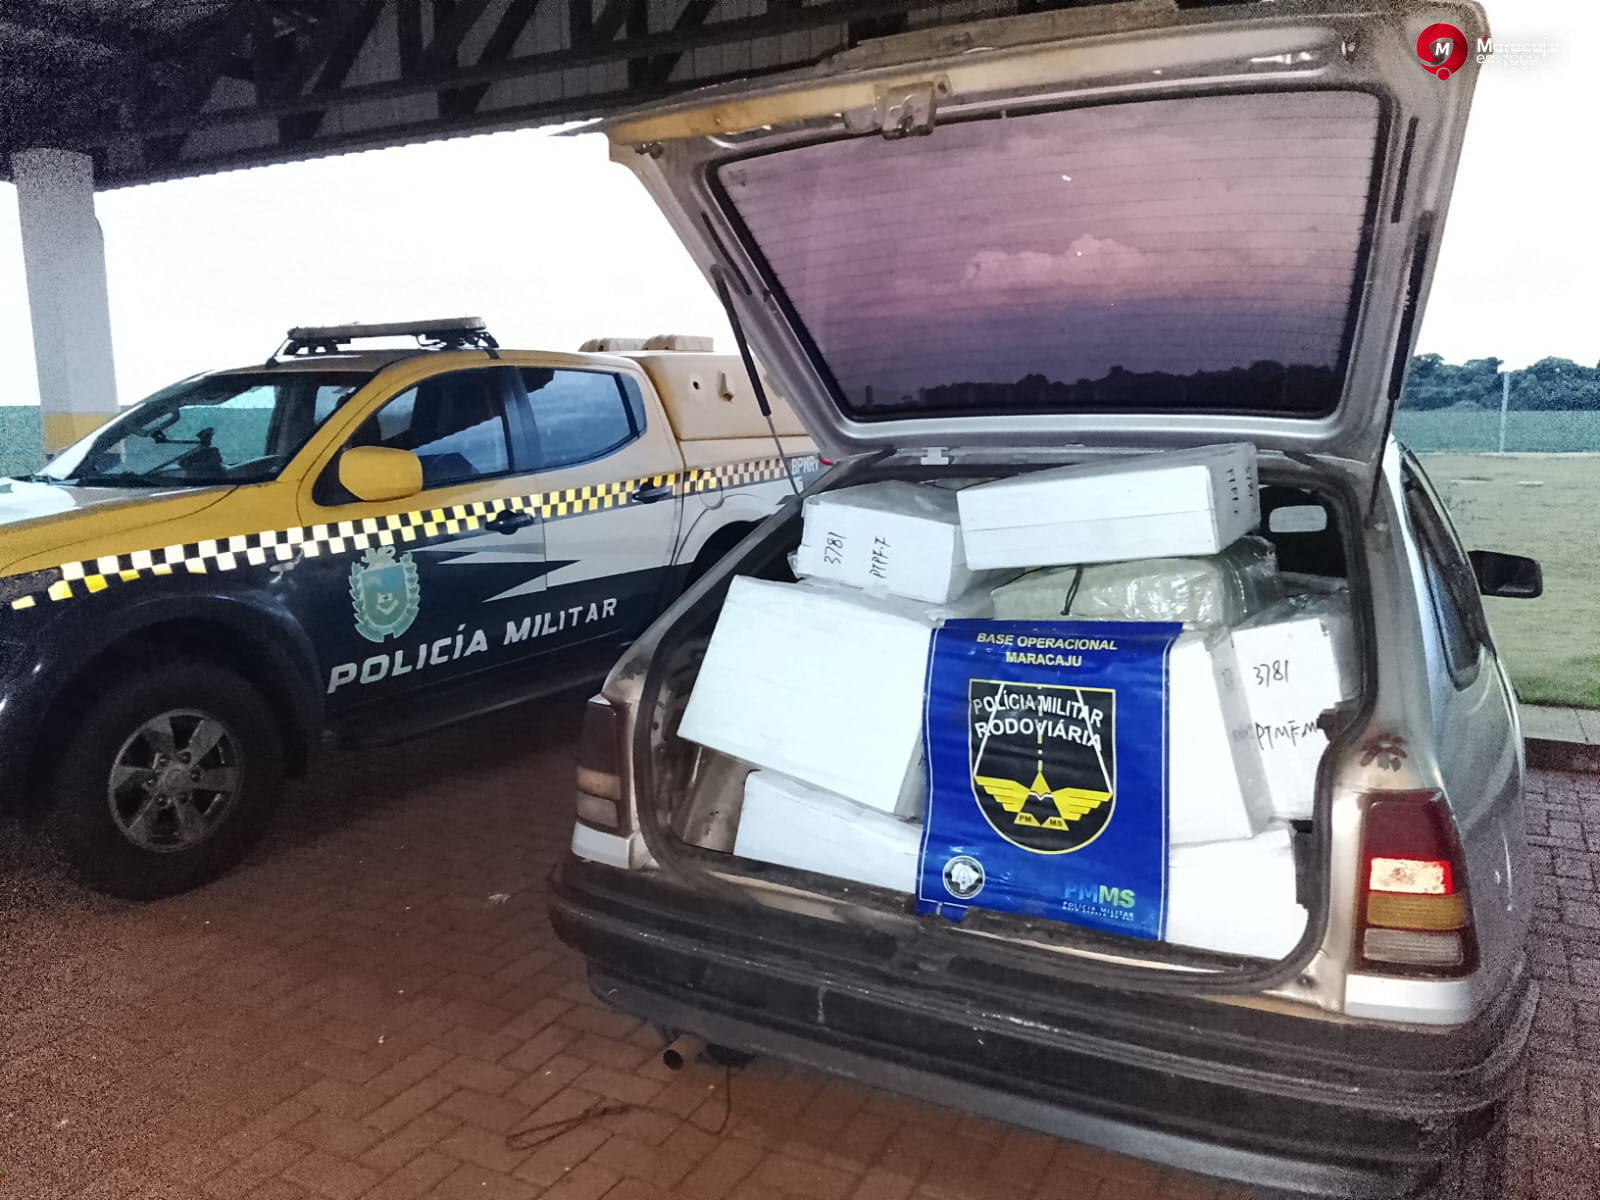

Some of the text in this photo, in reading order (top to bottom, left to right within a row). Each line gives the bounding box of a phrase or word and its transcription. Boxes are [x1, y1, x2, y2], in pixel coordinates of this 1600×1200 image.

[824, 531, 847, 565] 3781
[327, 598, 618, 694] POLÍCIA MILITAR
[976, 632, 1118, 651] BASE OPERACIONAL
[1005, 651, 1083, 667] MARACAJU
[1252, 659, 1289, 688] 3781
[973, 690, 1104, 728] POLÍCIA MILITAR
[973, 717, 1102, 750] RODOVIÁRIA
[1018, 814, 1033, 823] PM
